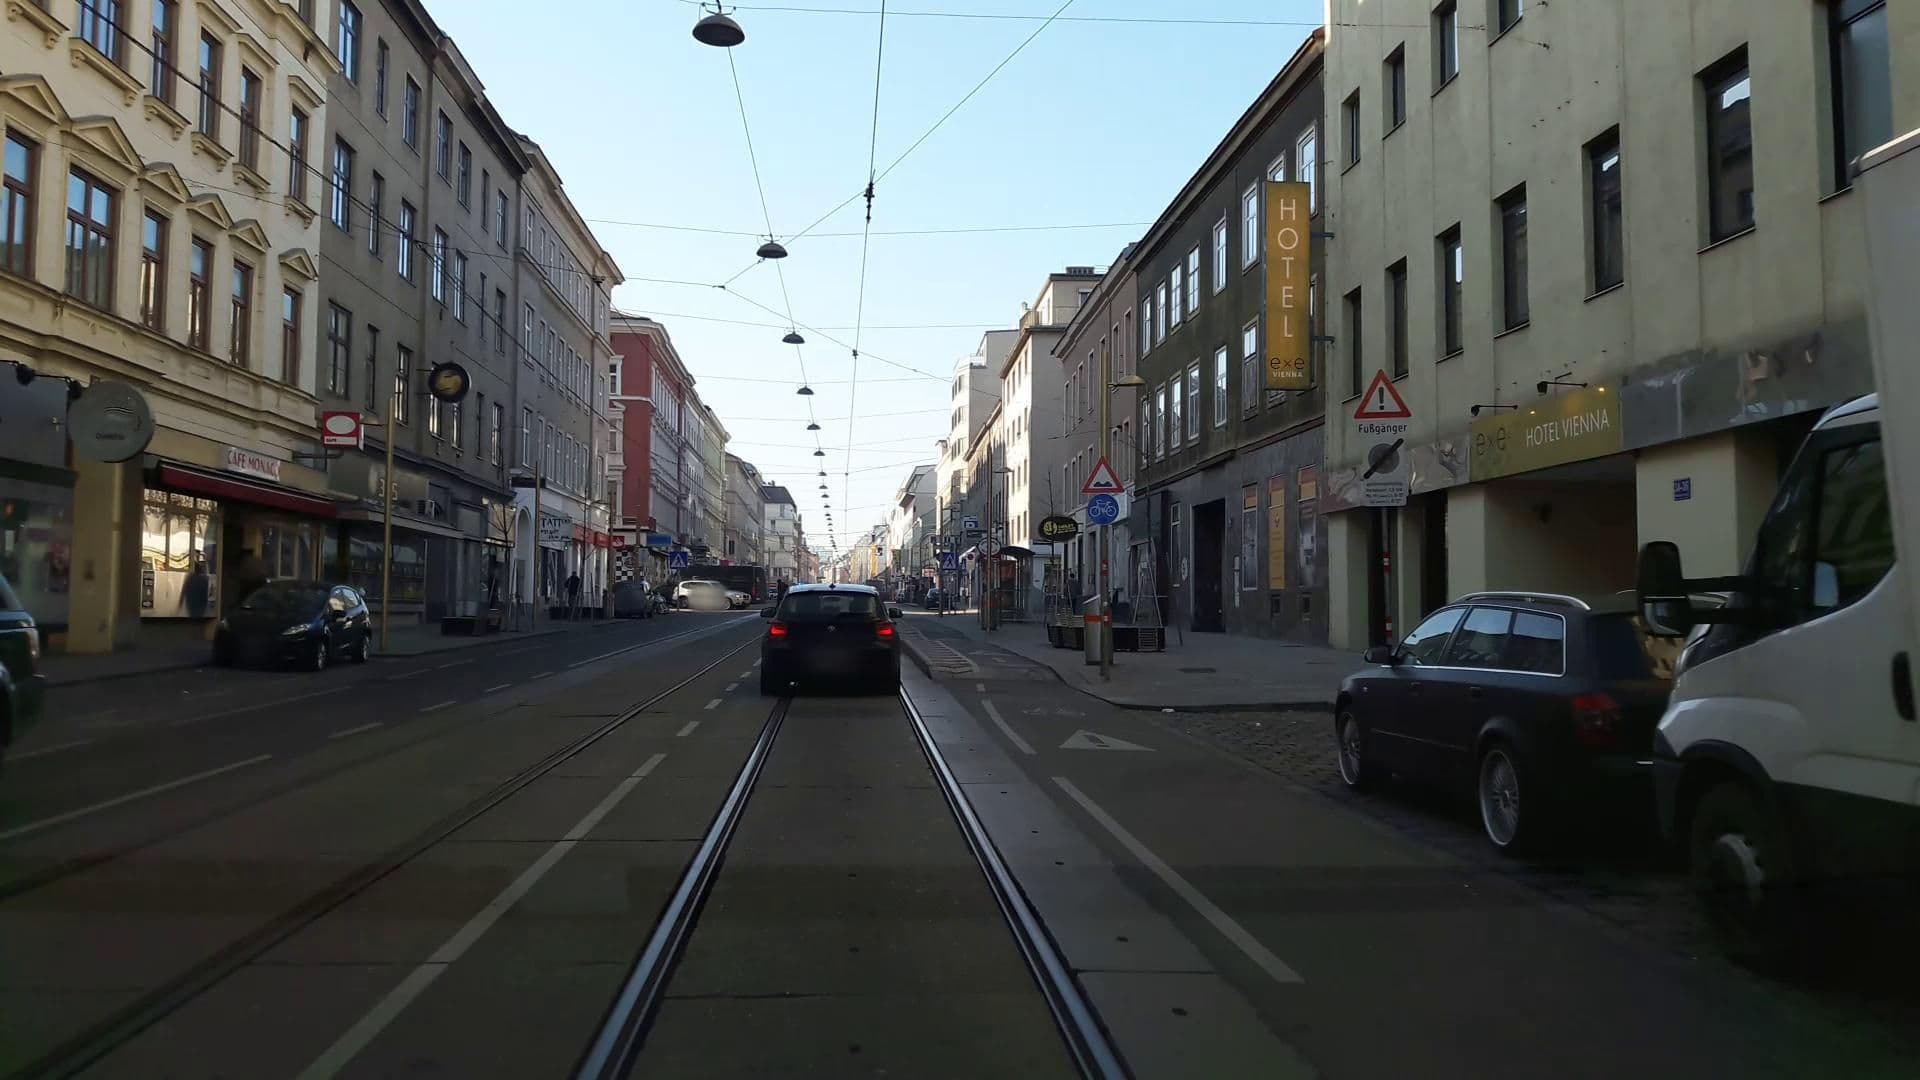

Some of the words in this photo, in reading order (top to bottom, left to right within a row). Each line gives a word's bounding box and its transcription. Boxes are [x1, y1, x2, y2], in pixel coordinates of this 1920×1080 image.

[1277, 198, 1299, 338] HOTEL
[1272, 370, 1304, 378] VIENNA
[1358, 423, 1408, 434] Fußgänger
[1525, 421, 1560, 448] HOTEL
[1561, 408, 1610, 439] VIENNA
[228, 450, 246, 468] CAFE
